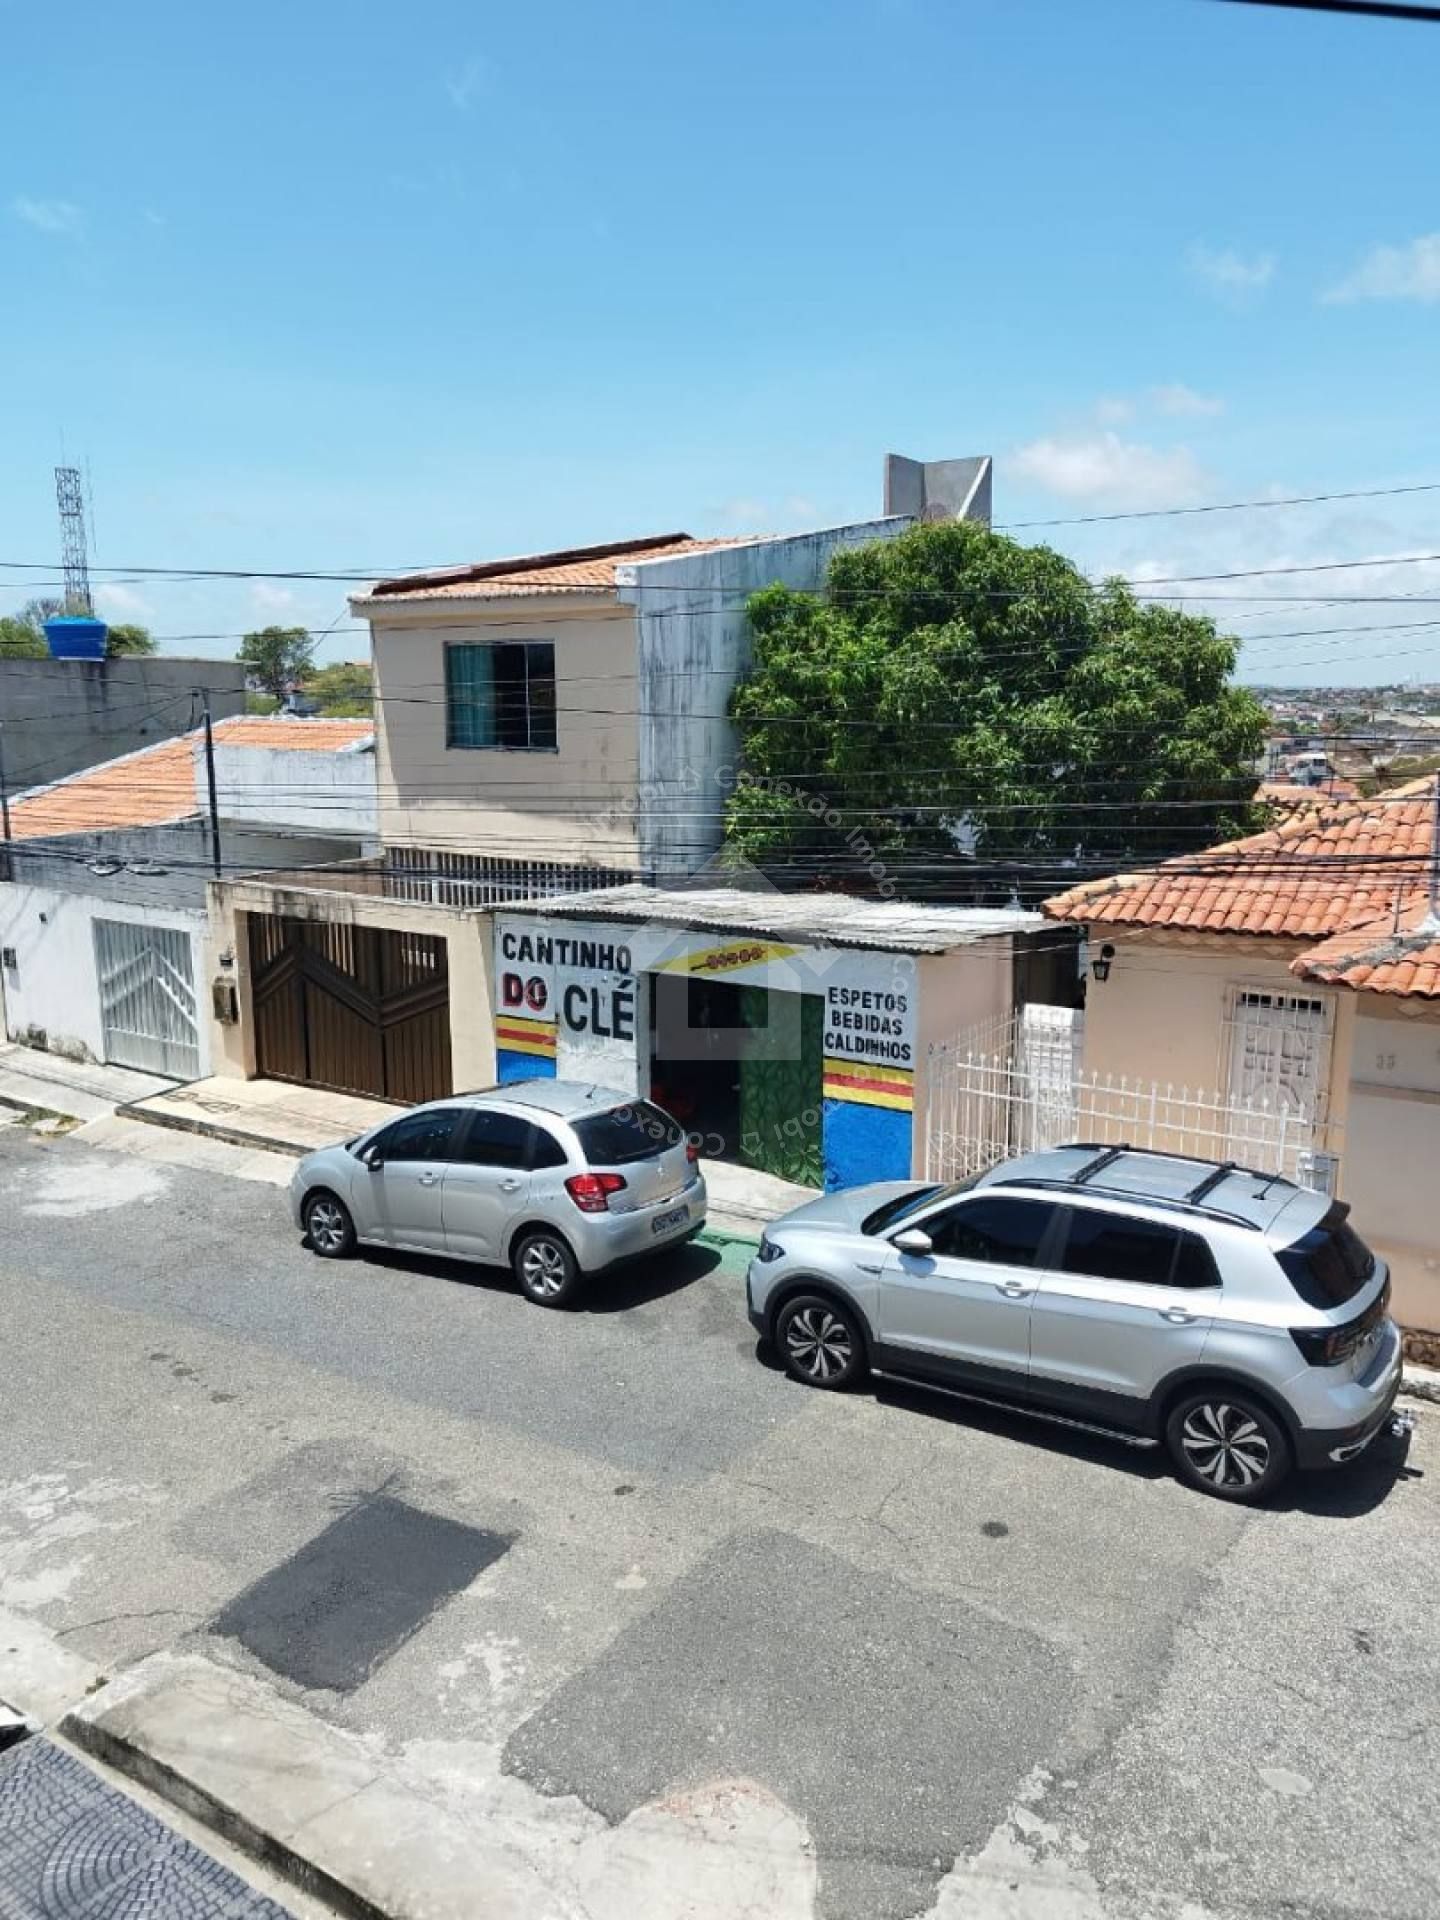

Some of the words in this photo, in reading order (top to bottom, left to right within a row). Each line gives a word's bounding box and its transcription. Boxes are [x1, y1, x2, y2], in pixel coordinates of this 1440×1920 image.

[502, 932, 632, 974] CANTINHO
[503, 973, 548, 1011] DO
[563, 978, 635, 1041] CLÉ
[828, 986, 908, 1013] ESPETOS
[831, 1009, 903, 1036] BEBIDAS
[824, 1031, 912, 1061] CALDINHOS
